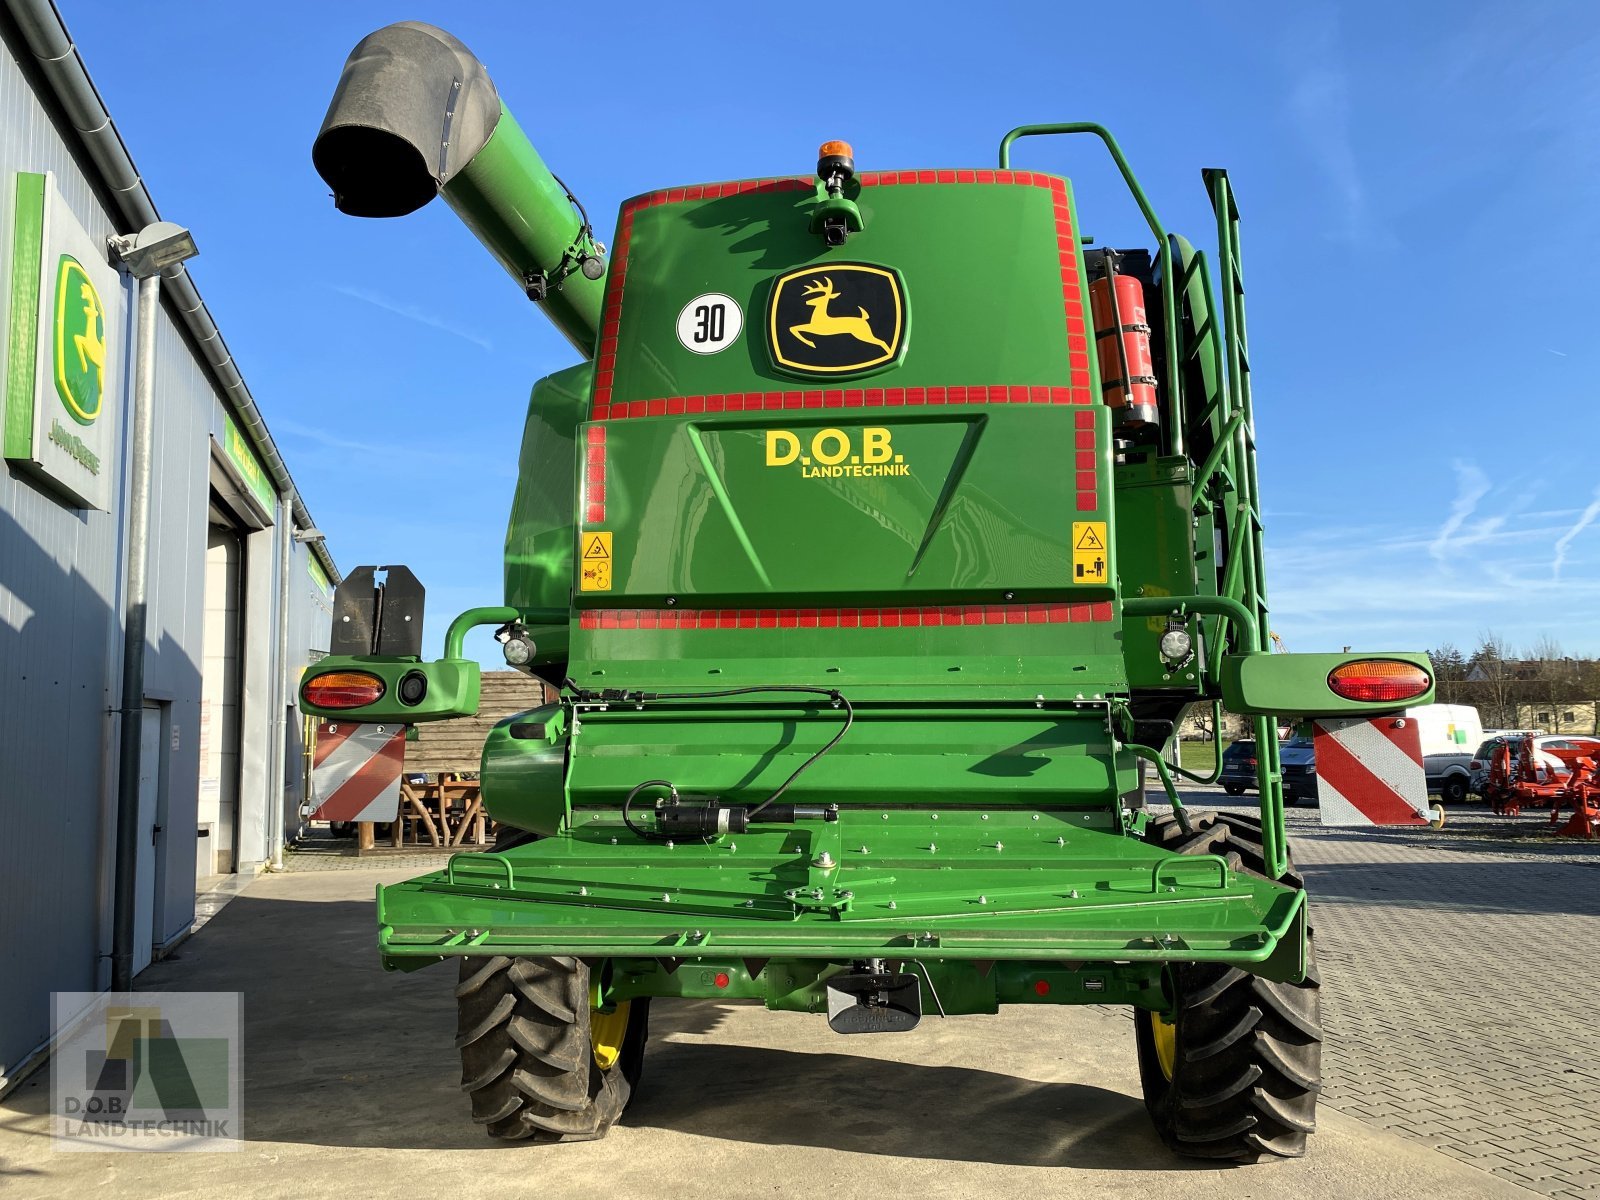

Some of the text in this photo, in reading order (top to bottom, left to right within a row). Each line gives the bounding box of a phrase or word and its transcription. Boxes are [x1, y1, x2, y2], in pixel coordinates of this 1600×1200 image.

[694, 304, 726, 343] 30
[766, 428, 904, 467] D.O.B.
[802, 464, 910, 479] LANDTECHNIK
